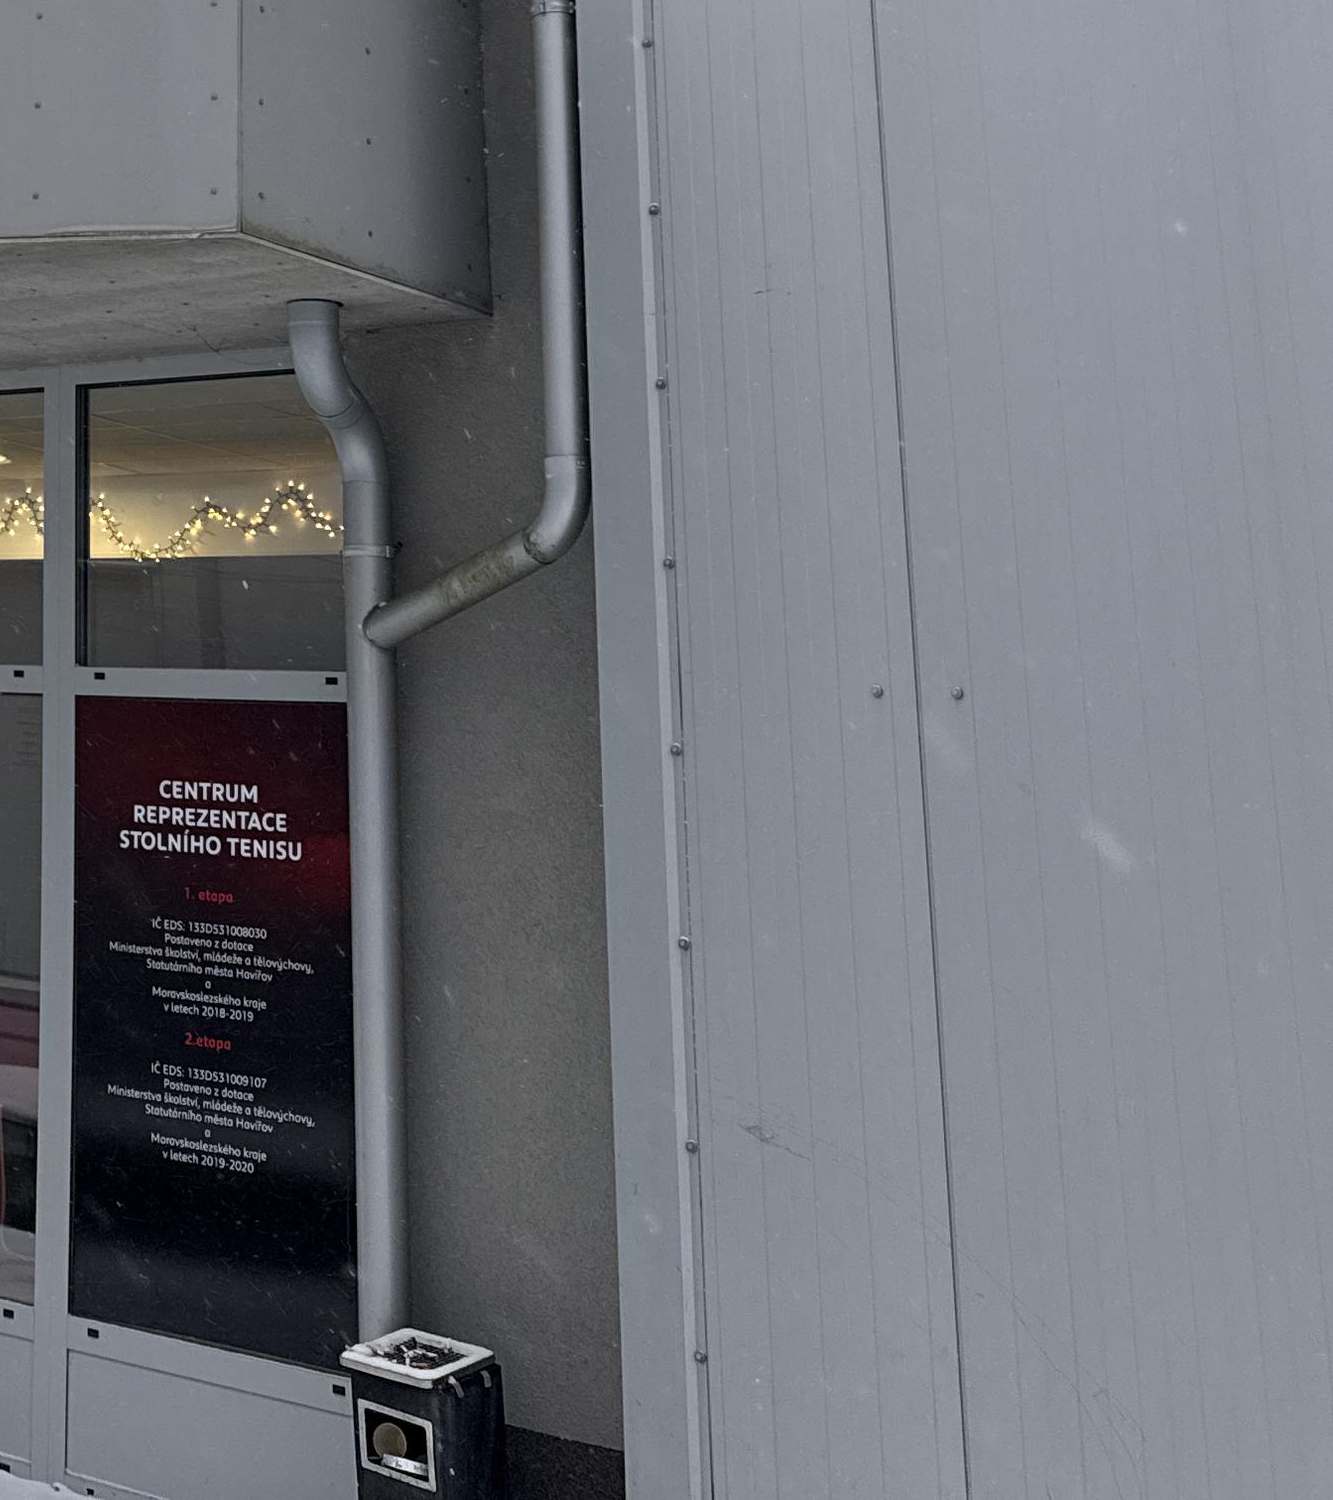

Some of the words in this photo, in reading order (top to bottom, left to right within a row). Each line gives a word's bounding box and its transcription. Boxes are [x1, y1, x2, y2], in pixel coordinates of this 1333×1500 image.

[159, 780, 259, 804] CENTRUM
[133, 804, 287, 833] REPREZENTACE
[119, 829, 221, 855] STOLNÍHO
[226, 837, 302, 861] TENISU
[198, 890, 234, 905] etapa
[164, 920, 185, 932] EDS:
[164, 933, 212, 948] Postaveno
[214, 941, 220, 949] z
[222, 939, 254, 952] dotace
[109, 941, 163, 956] Ministerstva
[165, 945, 201, 962] školství,
[203, 951, 243, 965] mládeže
[245, 956, 252, 965] a
[253, 956, 315, 974] tělovýchovy,
[146, 958, 203, 975] Statutárního
[205, 966, 233, 978] města
[236, 969, 273, 984] Havířov
[205, 980, 211, 989] a
[152, 986, 242, 1006] Moravskoslezského
[243, 997, 267, 1010] kraje
[164, 1003, 170, 1012] v
[171, 1002, 200, 1015] letech
[201, 1006, 254, 1022] 2018-2019
[151, 1060, 161, 1075] IČ
[163, 1064, 185, 1077] EDS:
[164, 1078, 212, 1095] Postaveno
[214, 1087, 219, 1097] z
[222, 1088, 254, 1102] dotace
[107, 1084, 162, 1102] Ministerstva
[164, 1093, 200, 1110] školství,
[203, 1099, 243, 1114] mládeže
[245, 1107, 252, 1115] a
[253, 1107, 315, 1128] tělovýchovy,
[145, 1104, 202, 1122] Statutárního
[204, 1113, 233, 1127] města
[236, 1118, 274, 1133] Havířov
[204, 1129, 211, 1138] a
[151, 1133, 241, 1157] Moravskoslezského
[243, 1147, 267, 1162] kraje
[162, 1151, 169, 1160] v
[170, 1150, 199, 1164] letech
[201, 1154, 255, 1174] 2019-2020
